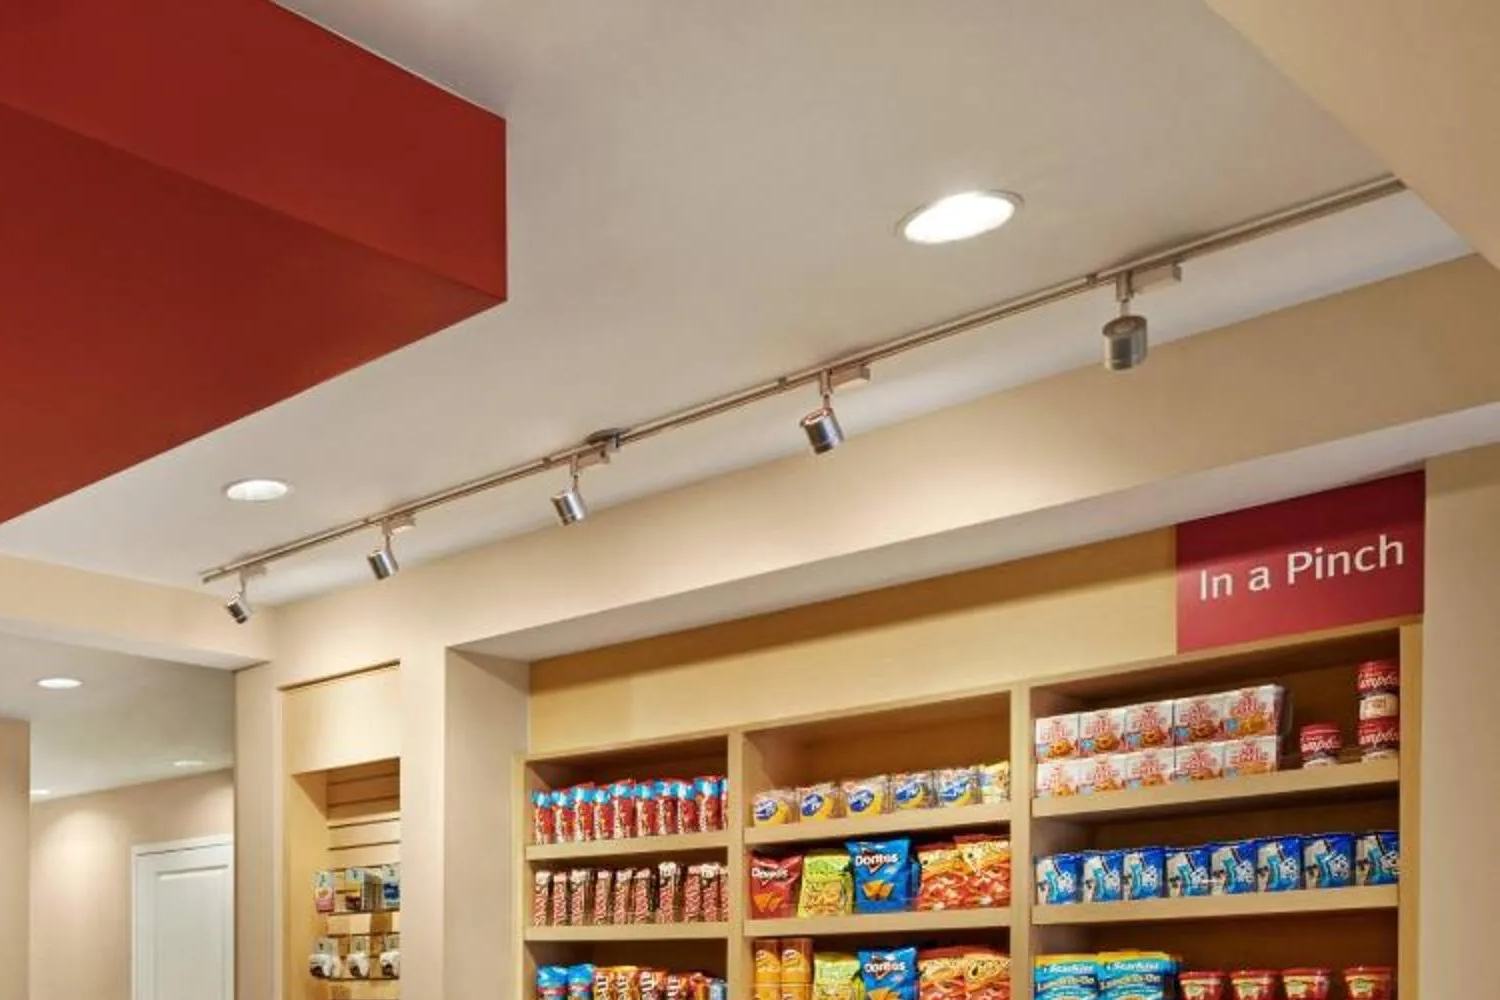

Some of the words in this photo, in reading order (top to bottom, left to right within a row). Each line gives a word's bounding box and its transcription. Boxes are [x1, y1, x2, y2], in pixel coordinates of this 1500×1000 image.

[1200, 568, 1233, 601] In
[1248, 565, 1271, 591] a
[1287, 534, 1404, 585] Pinch
[855, 853, 898, 867] Doritos
